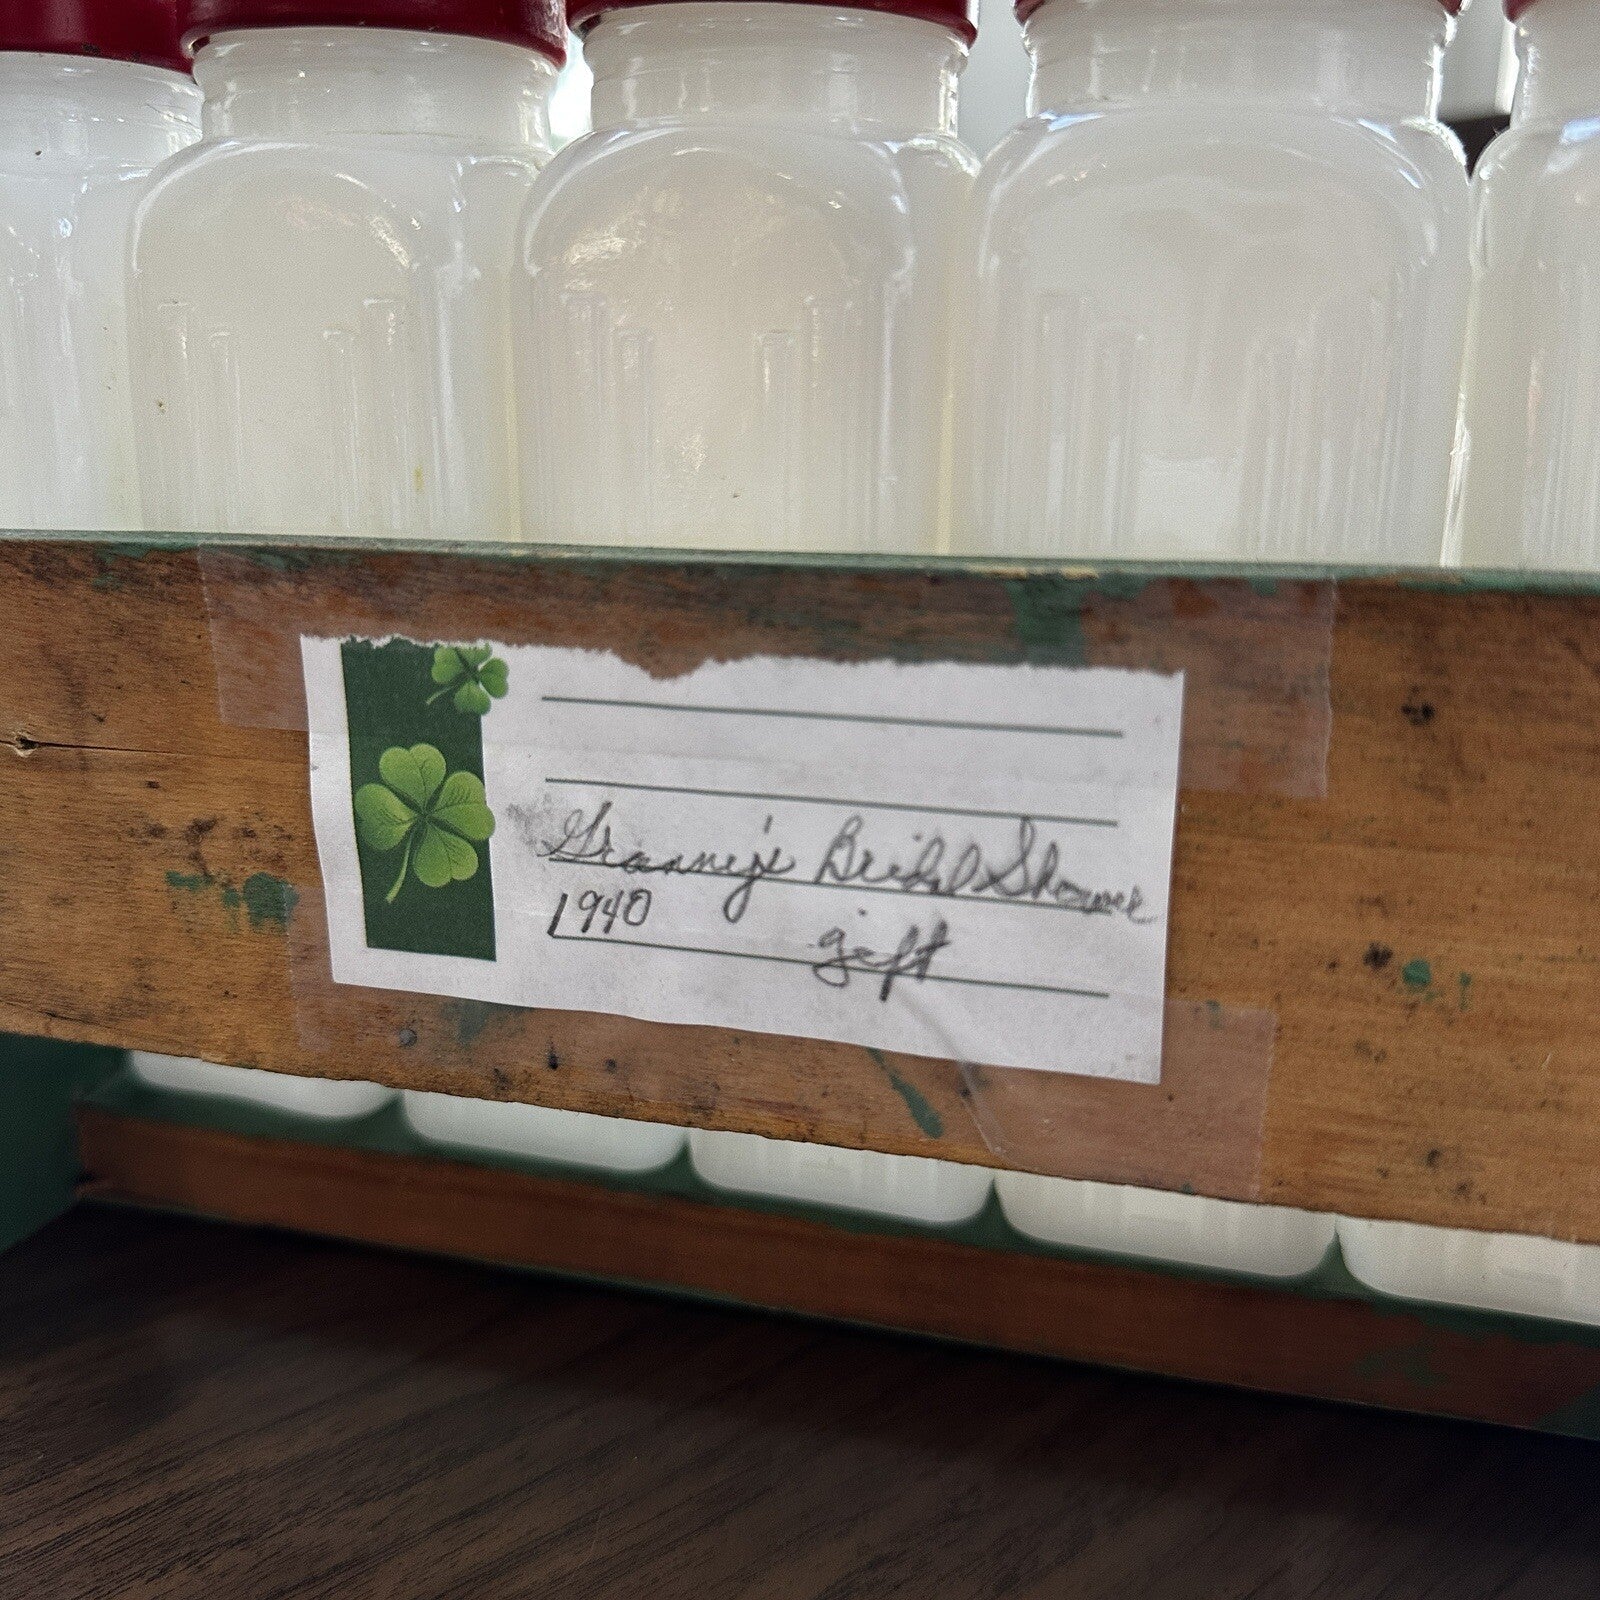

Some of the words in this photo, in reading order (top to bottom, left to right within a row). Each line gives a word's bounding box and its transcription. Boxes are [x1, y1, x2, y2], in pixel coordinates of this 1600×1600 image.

[547, 888, 652, 936] 1940
[973, 814, 1158, 925] Shower
[811, 907, 951, 1002] gift
